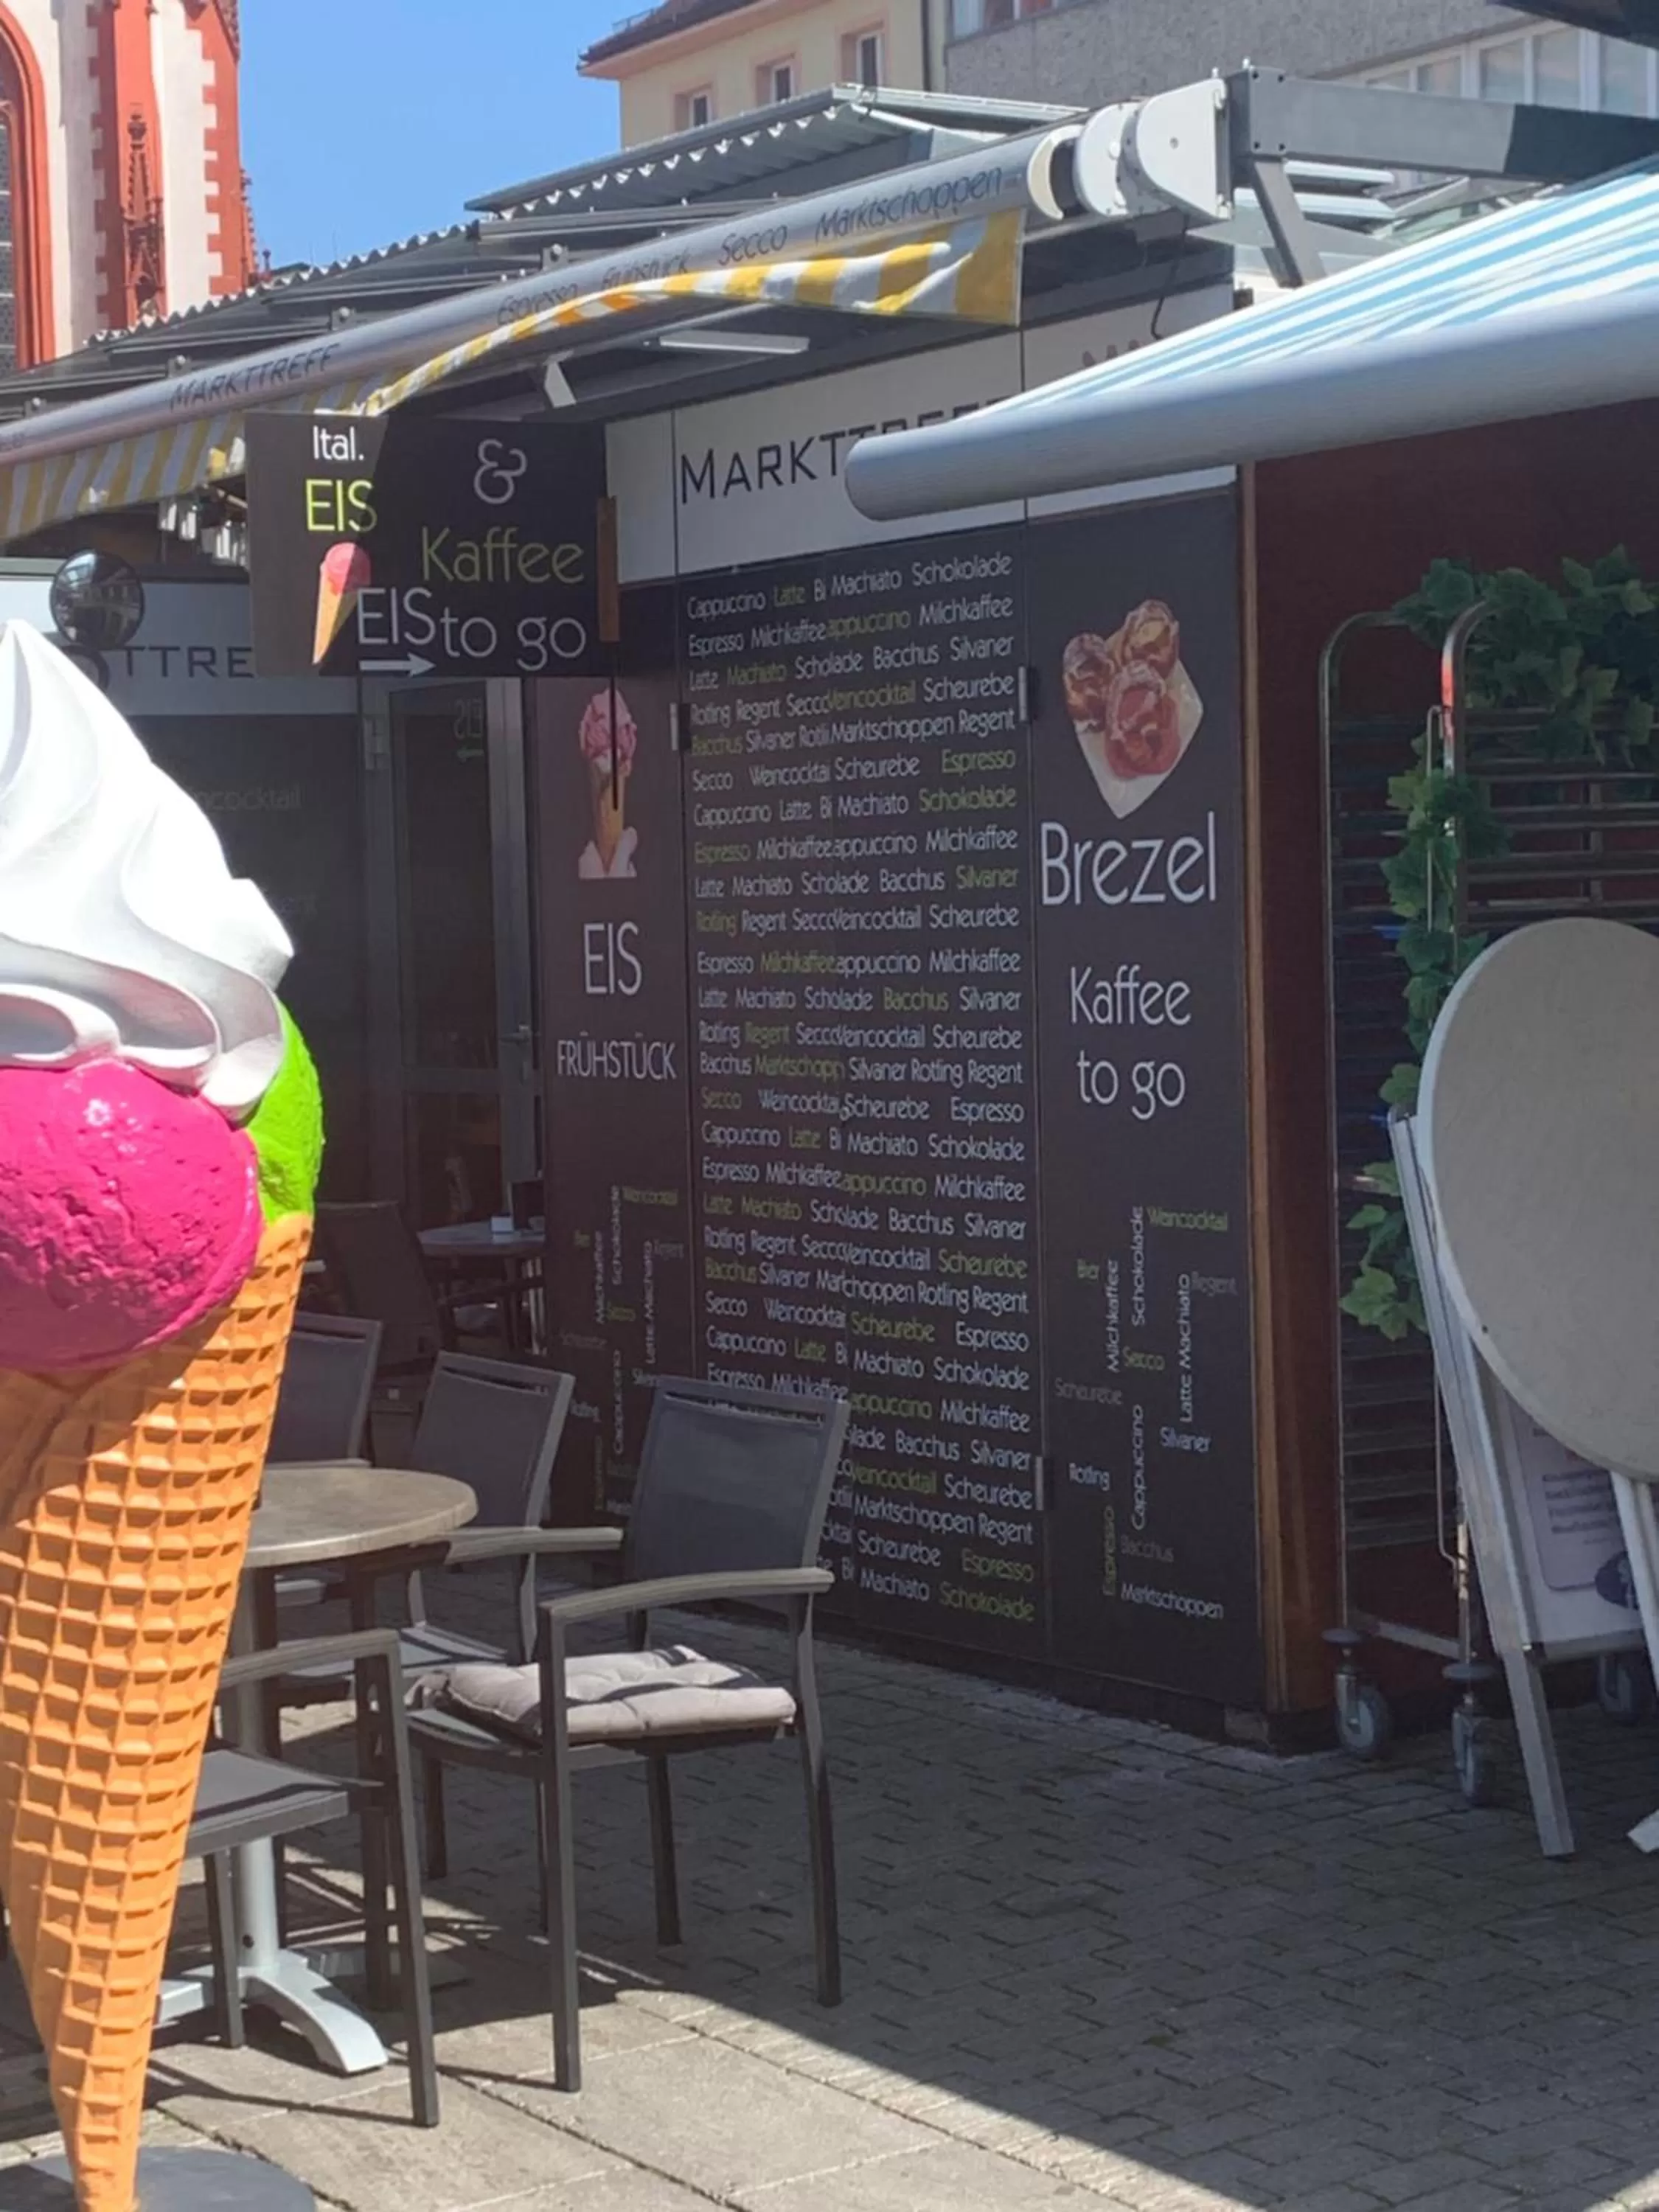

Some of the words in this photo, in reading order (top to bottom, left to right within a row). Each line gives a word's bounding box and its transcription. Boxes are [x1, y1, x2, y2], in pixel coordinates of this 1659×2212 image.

[717, 224, 787, 267] Secco
[814, 166, 1003, 246] Marktschoppen
[170, 342, 341, 414] MARKTTREFF
[312, 425, 365, 462] Ital.
[473, 438, 529, 506] &
[305, 479, 378, 534] EIS
[421, 526, 585, 585] Kaffee
[911, 552, 1014, 587] Schokolade
[919, 592, 1014, 626] Milchkaffee
[357, 587, 437, 646] EIS
[440, 607, 498, 658] to
[516, 616, 587, 672] go
[873, 641, 939, 670] Bacchus
[950, 636, 1015, 662] Silvaner
[922, 669, 1015, 702] Scheurebe
[831, 714, 954, 743] Marktschoppen
[959, 707, 1015, 738] Regent
[834, 751, 921, 781] Scheurebe
[941, 748, 1016, 777] Espresso
[918, 784, 1017, 812] Schokolade
[926, 823, 1018, 852] Milchkaffee
[1040, 810, 1217, 907] Brezel
[879, 866, 946, 892] Bacchus
[955, 864, 1019, 890] Silvaner
[928, 902, 1020, 929] Scheurebe
[582, 920, 643, 996] EIS
[929, 947, 1021, 974] Milchkaffee
[884, 986, 950, 1012] Bacchus
[959, 985, 1022, 1012] Silvaner
[1070, 964, 1193, 1026] Kaffee
[932, 1023, 1023, 1049] Scheurebe
[557, 1030, 678, 1081] FRÜHSTÜCK
[849, 1056, 908, 1082] Silvaner
[967, 1058, 1024, 1090] Regent
[1077, 1050, 1119, 1105] to
[1130, 1060, 1186, 1121] go
[844, 1093, 931, 1121] Scheurebe
[950, 1096, 1026, 1126] Espresso
[928, 1133, 1025, 1161] Schokolade
[934, 1173, 1026, 1203] Milchkaffee
[888, 1208, 955, 1237] Bacchus
[964, 1212, 1027, 1241] Silvaner
[938, 1248, 1029, 1279] Scheurebe
[1130, 1205, 1146, 1328] Schokolade
[973, 1285, 1029, 1318] Regent
[1105, 1259, 1121, 1374] Milchkaffee
[850, 1311, 936, 1343] Scheurebe
[955, 1321, 1030, 1352] Espresso
[1176, 1273, 1192, 1370] Machiato
[933, 1356, 1030, 1391] Schokolade
[940, 1398, 1030, 1433] Milchkaffee
[1179, 1374, 1193, 1424] Latte
[894, 1429, 961, 1461] Bacchus
[970, 1439, 1031, 1471] Silvaner
[1159, 1425, 1211, 1454] Silvaner
[1130, 1403, 1147, 1531] Cappuccino
[944, 1473, 1033, 1510] Scheurebe
[854, 1493, 974, 1534] Marktschoppen
[978, 1512, 1034, 1546] Regent
[857, 1528, 942, 1568] Scheurebe
[961, 1548, 1034, 1583] Espresso
[939, 1580, 1034, 1622] Schokolade
